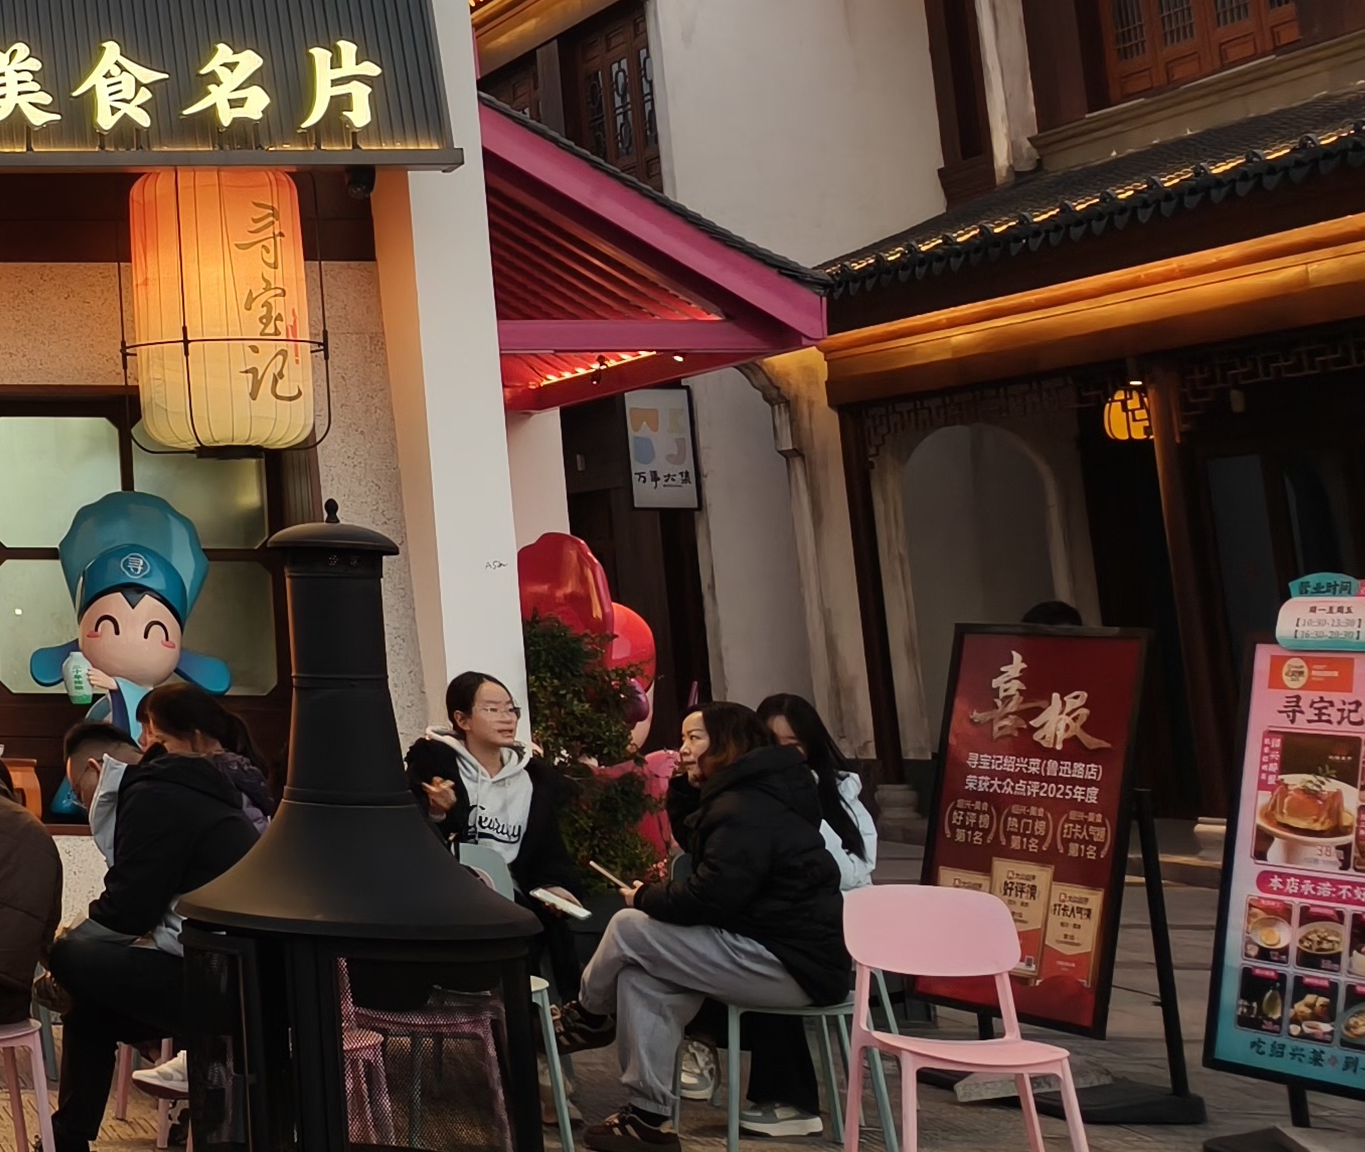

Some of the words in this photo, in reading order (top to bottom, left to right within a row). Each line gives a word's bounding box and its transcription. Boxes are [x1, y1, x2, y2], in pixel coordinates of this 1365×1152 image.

[235, 201, 303, 402] 寻宝记
[1299, 581, 1352, 595] 营业时间
[970, 650, 1111, 750] 喜报
[1277, 694, 1365, 727] 寻宝记
[966, 752, 1103, 781] 寻宝记绍兴菜(鲁迅路店)
[965, 775, 1099, 803] 荣获大众点评2025年度
[952, 810, 990, 829] 好评榜
[1006, 816, 1046, 836] 热门榜
[954, 829, 983, 845] 第1名
[1010, 836, 1039, 852] 第1名
[1068, 843, 1097, 859] 第1名
[1003, 880, 1037, 901] 好评榜
[1250, 1038, 1326, 1067] 吃绍兴菜
